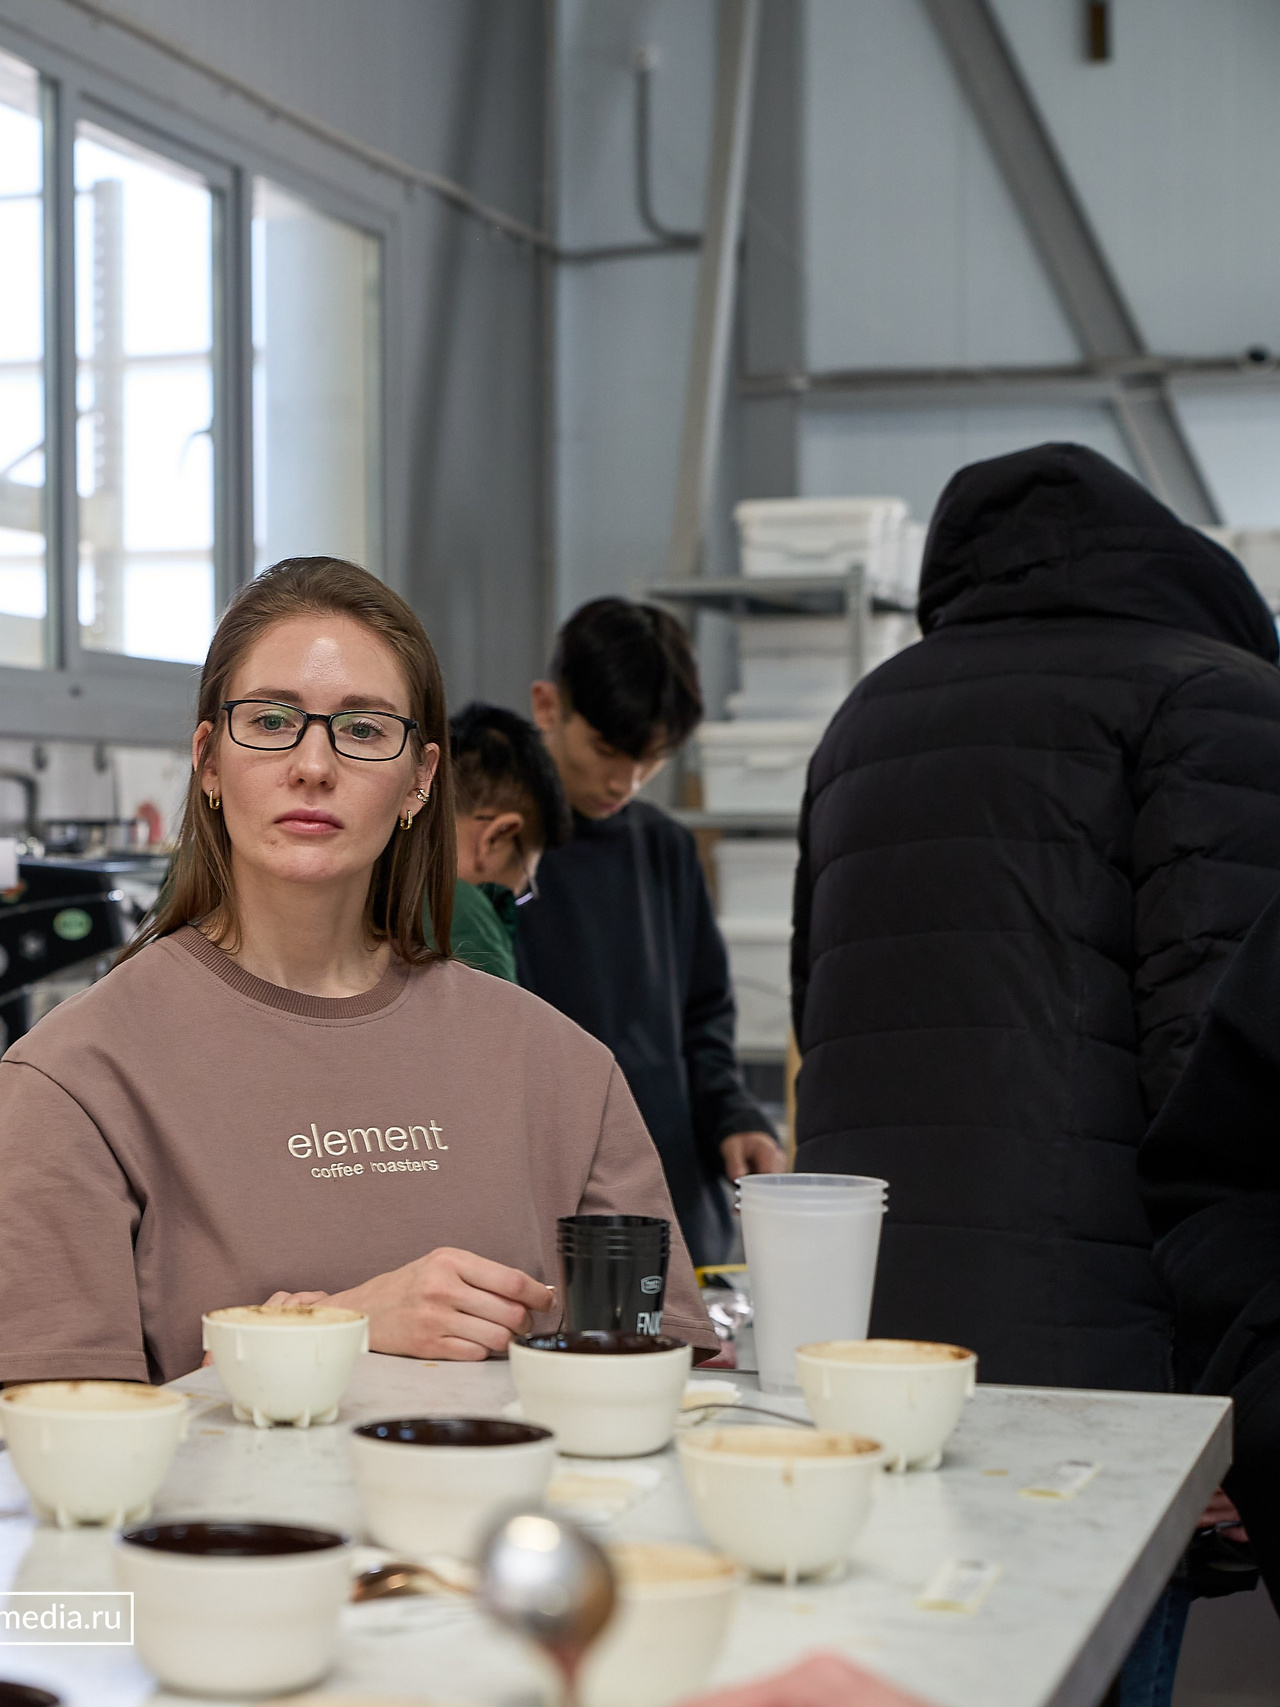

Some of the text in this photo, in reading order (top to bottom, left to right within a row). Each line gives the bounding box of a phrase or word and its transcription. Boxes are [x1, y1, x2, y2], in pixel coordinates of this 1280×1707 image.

[287, 1119, 449, 1159] element
[311, 1158, 439, 1179] coffee roasters
